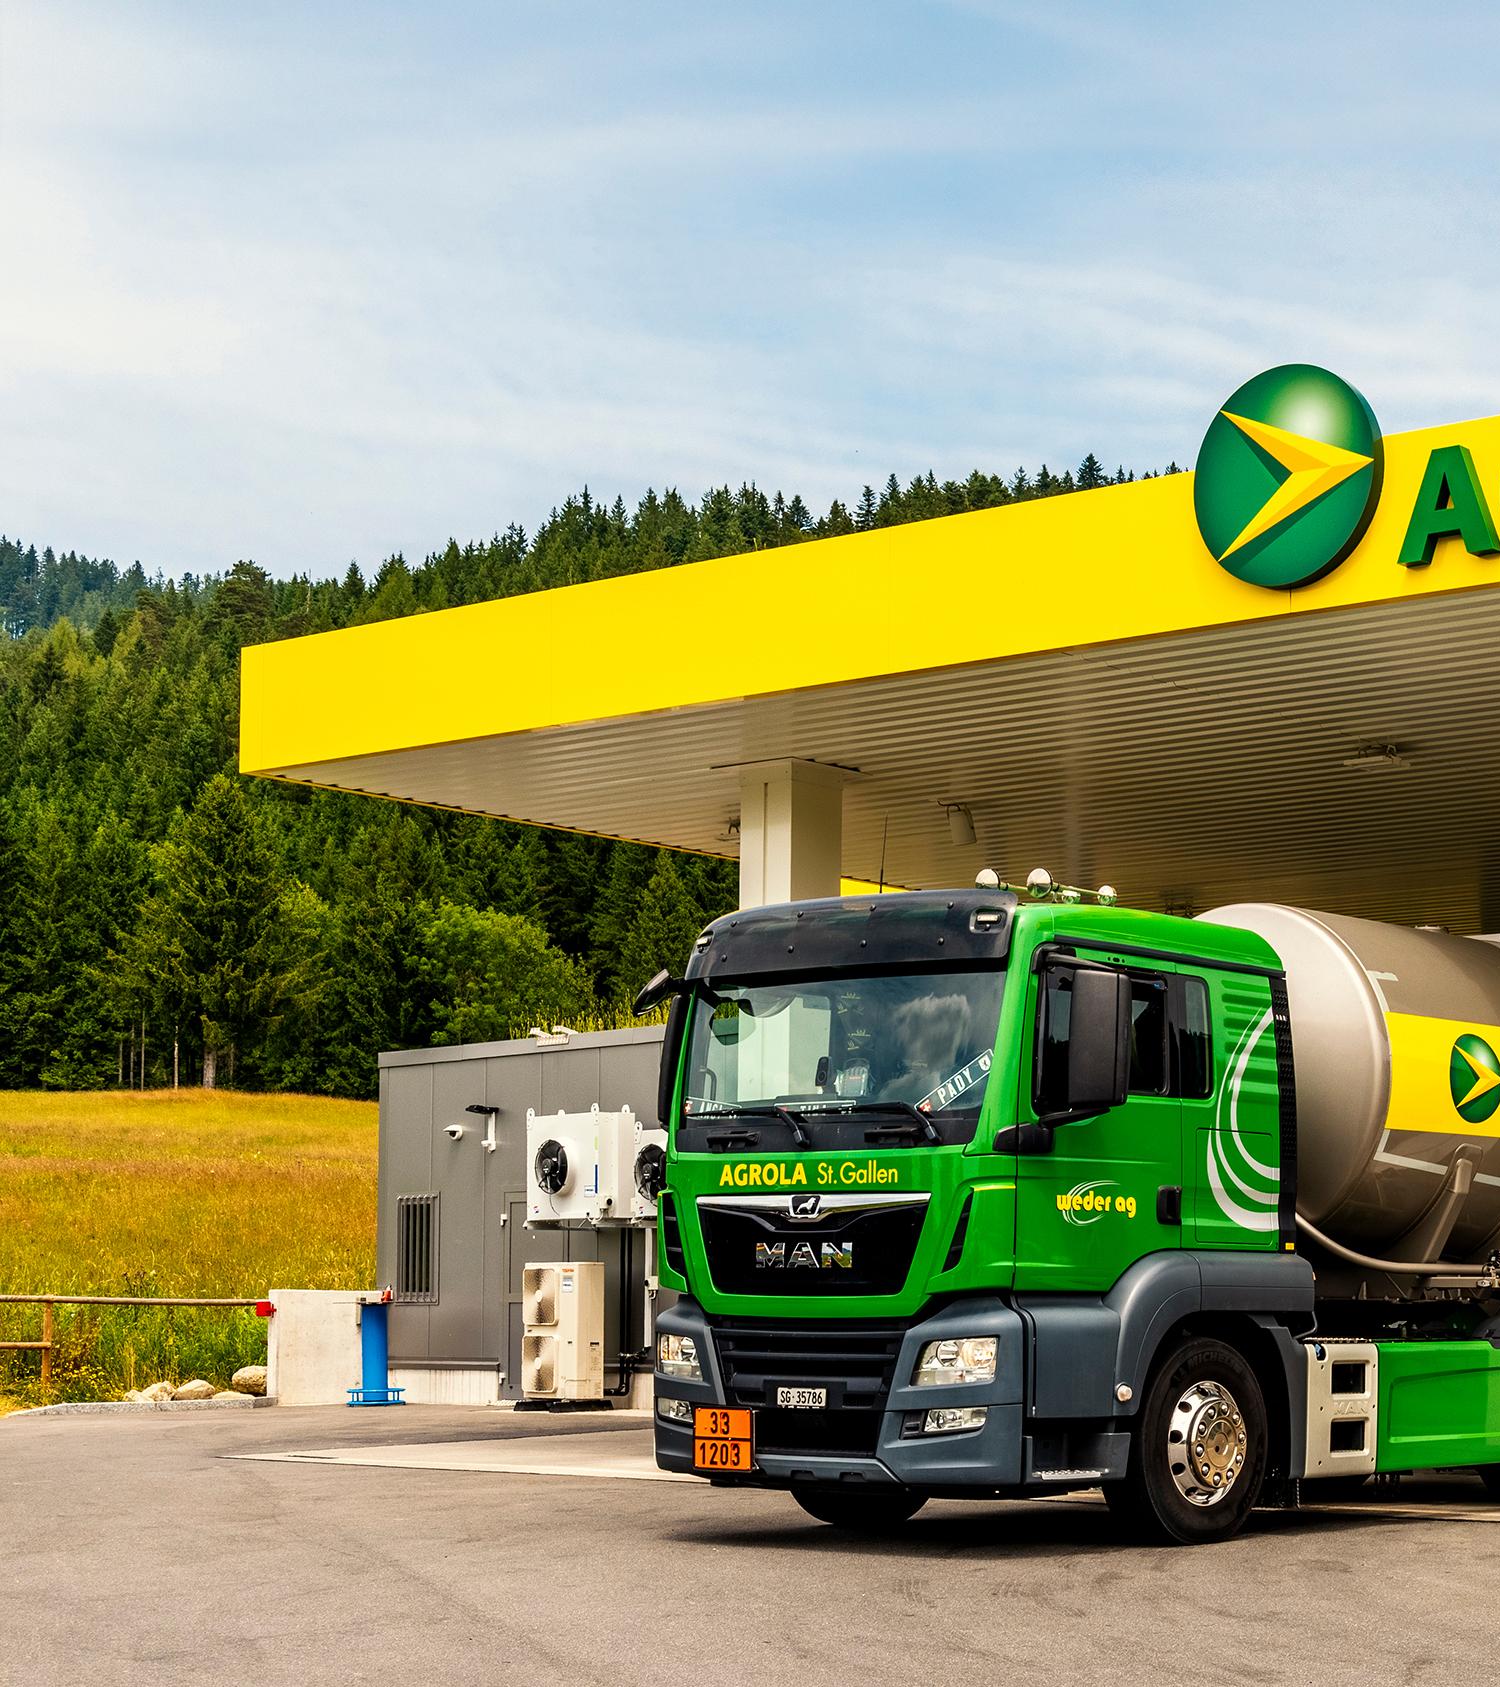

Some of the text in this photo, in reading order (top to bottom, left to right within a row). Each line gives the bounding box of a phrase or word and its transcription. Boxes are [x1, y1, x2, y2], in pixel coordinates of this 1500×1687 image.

[937, 1067, 973, 1105] PÄDY
[719, 1162, 808, 1187] AGROLA
[1056, 1190, 1137, 1219] weder ag
[755, 1242, 853, 1269] MAN
[710, 1411, 730, 1435] 33
[699, 1442, 741, 1467] 1203
